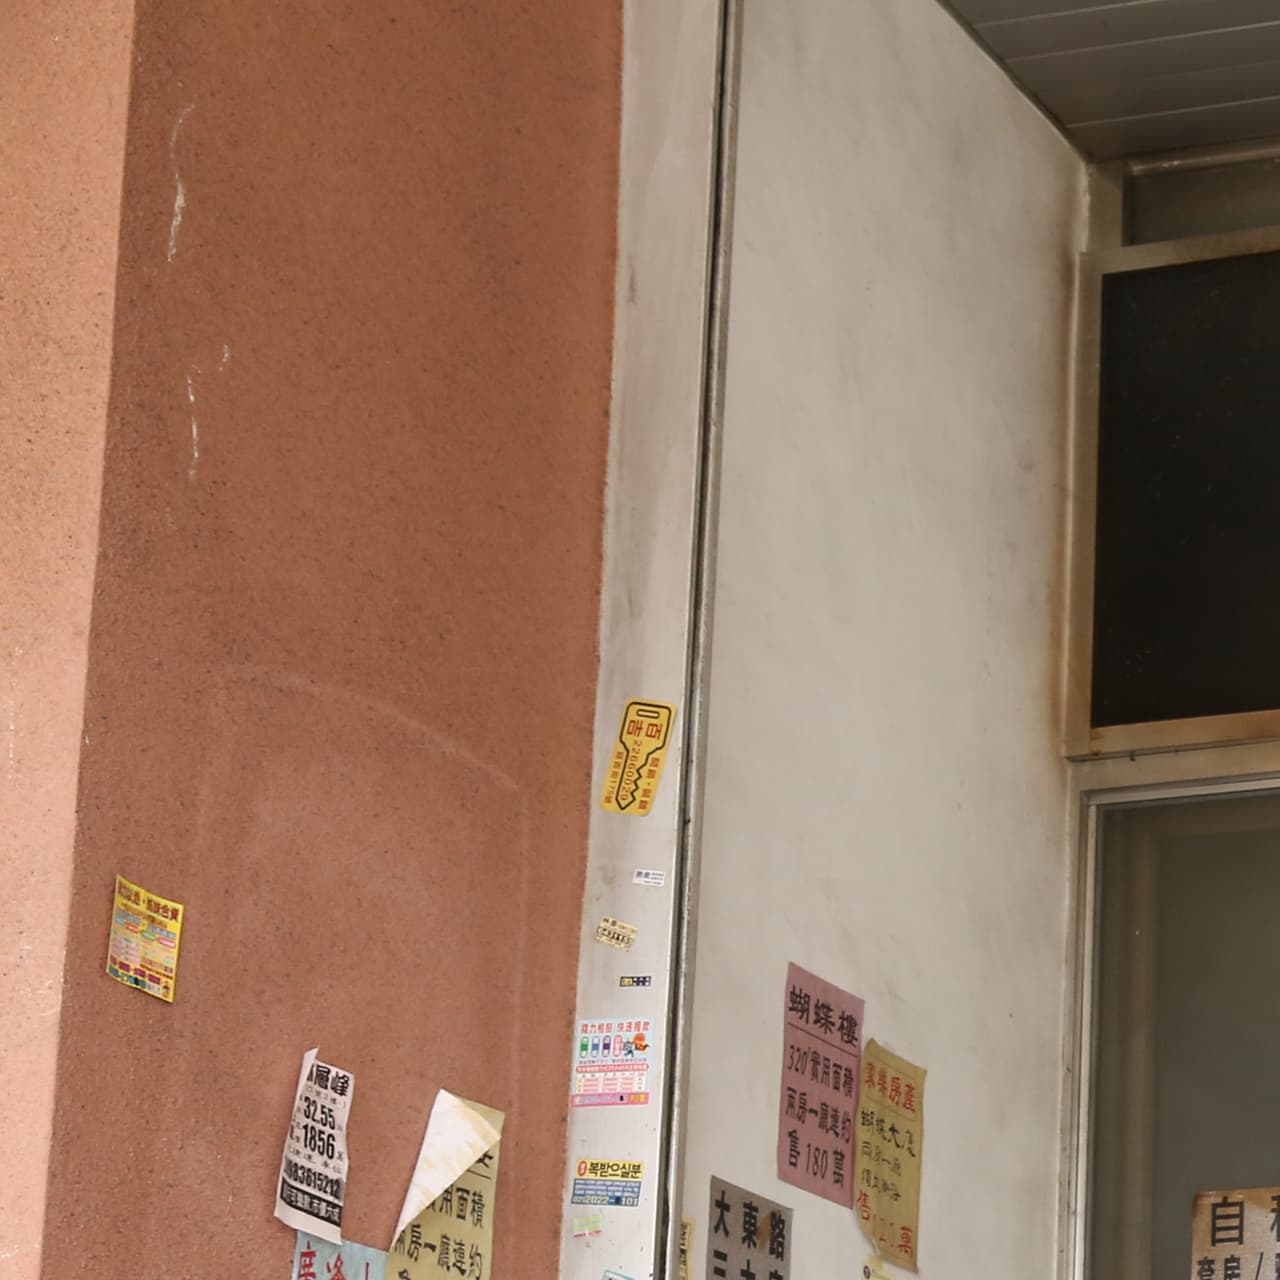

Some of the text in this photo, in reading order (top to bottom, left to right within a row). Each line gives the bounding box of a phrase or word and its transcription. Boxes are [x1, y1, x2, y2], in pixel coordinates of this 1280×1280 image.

[302, 1123, 337, 1160] 1856
[714, 1189, 786, 1262] 大東路
